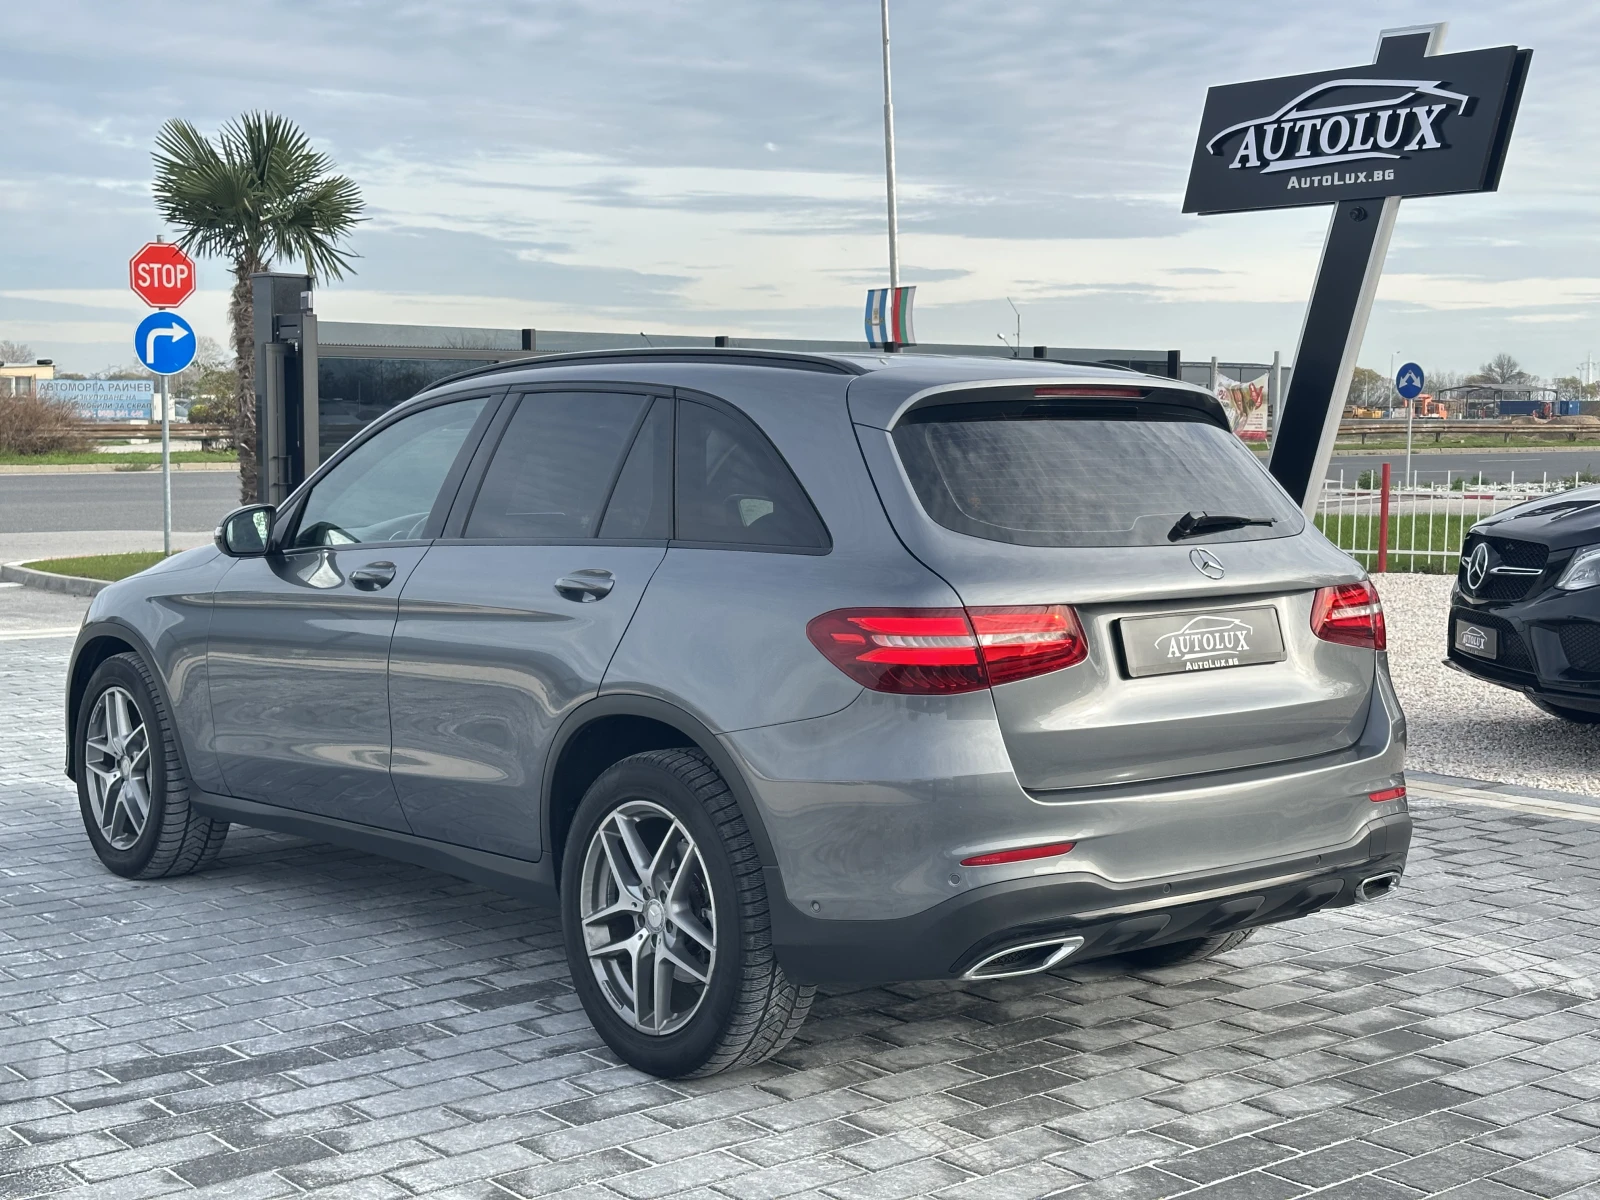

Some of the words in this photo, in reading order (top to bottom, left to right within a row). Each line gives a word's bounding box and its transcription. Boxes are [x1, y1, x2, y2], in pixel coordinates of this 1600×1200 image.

[1229, 104, 1446, 168] AUTOLUX
[138, 262, 188, 288] STOP
[39, 383, 105, 392] АВТОМОРГА
[1167, 630, 1249, 657] AUTOLUX
